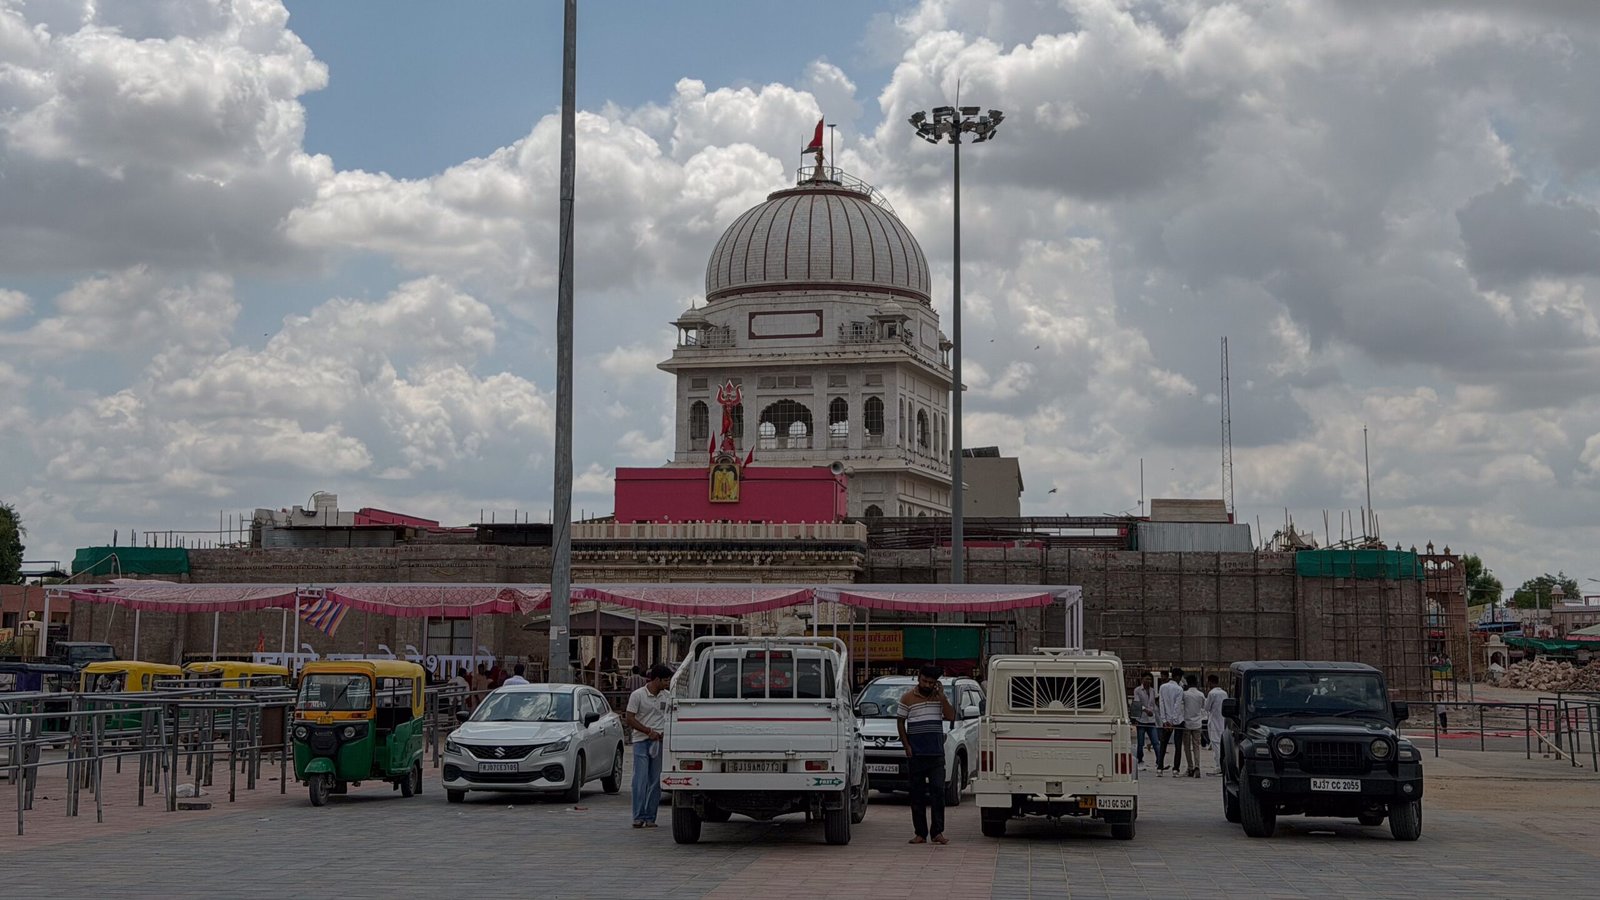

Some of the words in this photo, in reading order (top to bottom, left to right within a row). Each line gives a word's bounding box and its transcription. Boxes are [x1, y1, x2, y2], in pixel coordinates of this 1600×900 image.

[1312, 780, 1330, 789] RJ37
[1331, 781, 1341, 789] CC
[1342, 781, 1360, 790] 2055
[1098, 799, 1111, 808] RJ13
